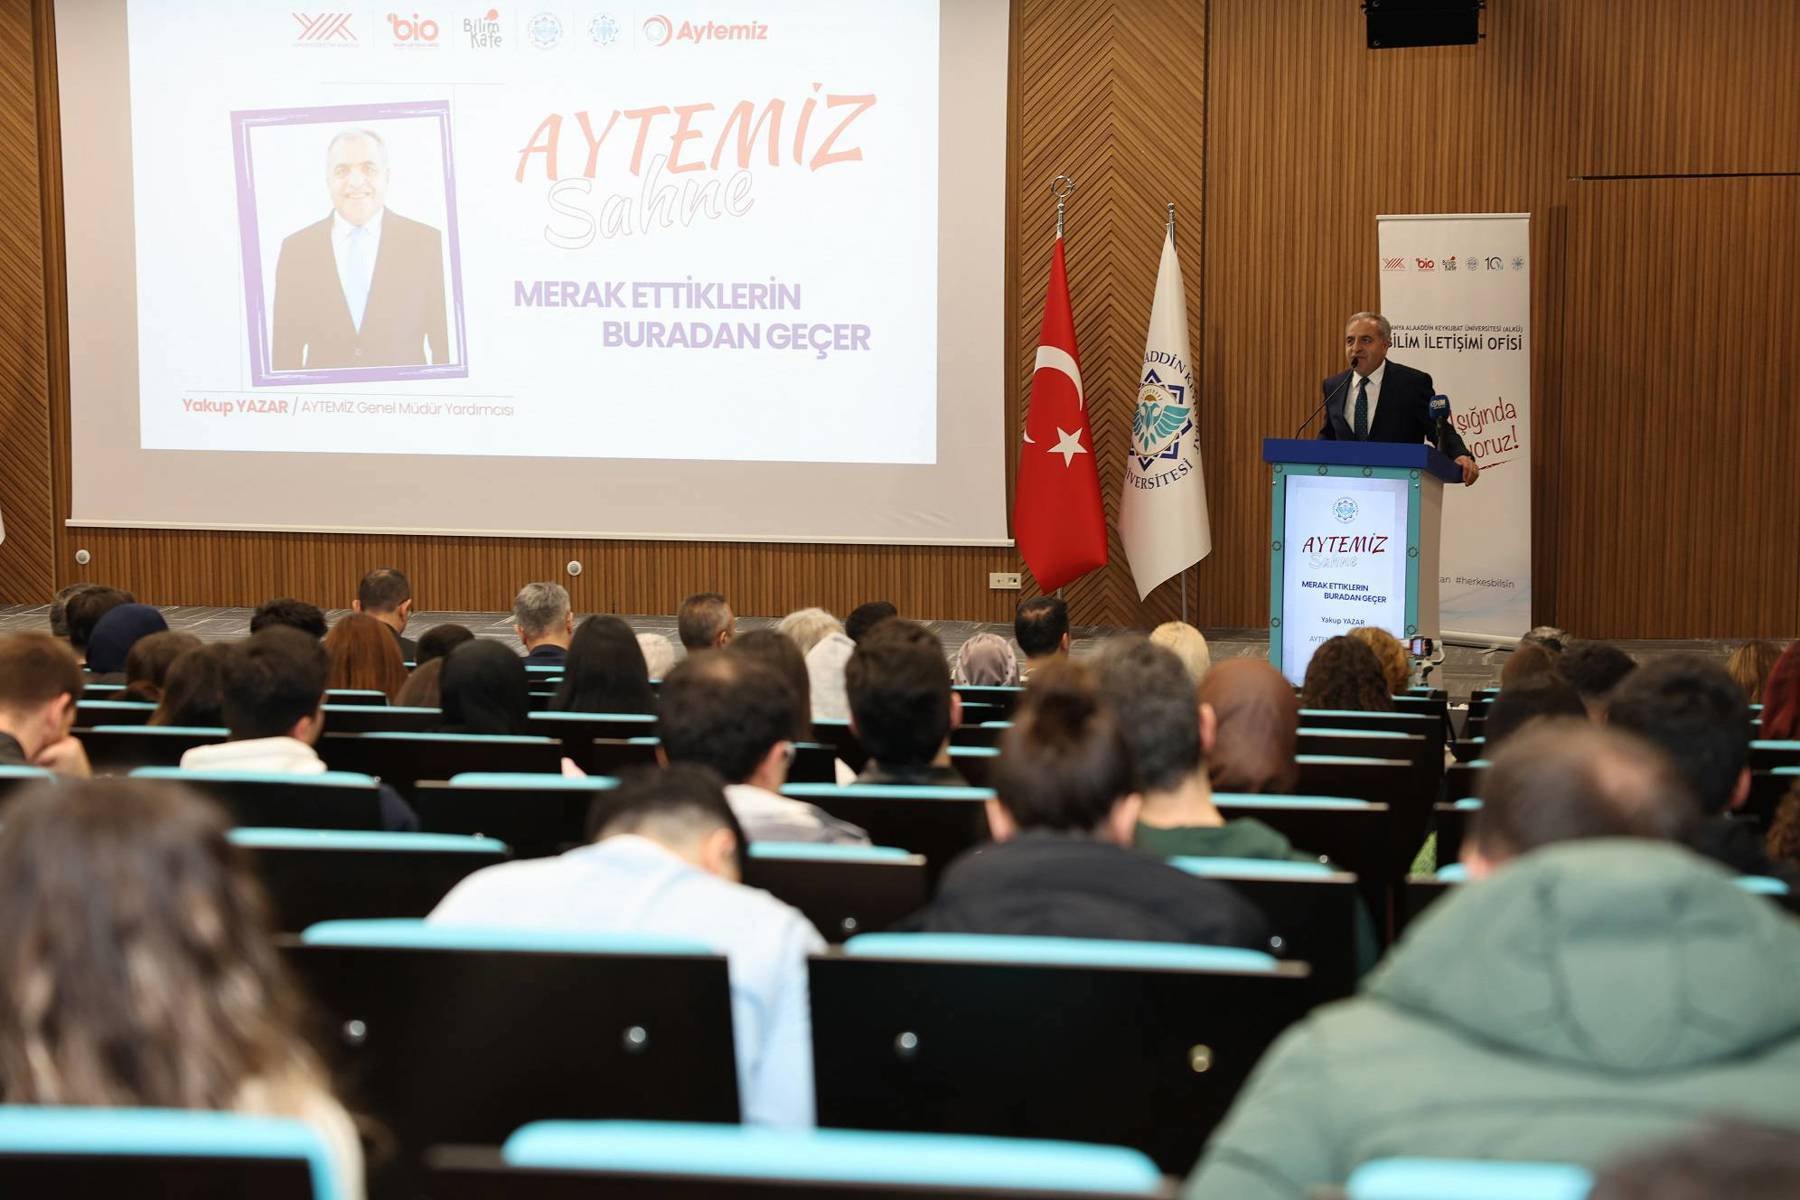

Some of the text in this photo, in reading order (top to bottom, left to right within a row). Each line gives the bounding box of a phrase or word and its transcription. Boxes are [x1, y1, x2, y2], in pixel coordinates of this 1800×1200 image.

[391, 14, 439, 42] bio
[463, 17, 500, 35] Bilim
[676, 21, 768, 44] Aytemiz
[471, 32, 503, 49] Kafe
[514, 82, 877, 183] AYTEMİZ
[544, 153, 755, 249] Sahne
[514, 275, 801, 310] MERAK ETTİKLERİN
[602, 321, 871, 360] BURADAN GEÇER
[1390, 333, 1523, 352] İLİM İLETİŞİMİ OFİSİ
[182, 398, 233, 416] Yakup
[236, 399, 288, 414] YAZAR
[301, 399, 354, 413] AYTEMİZ
[356, 401, 395, 414] Genel
[399, 401, 442, 415] Müdür
[1469, 425, 1519, 458] oruz!
[1302, 533, 1388, 554] AYTEMİZ
[1301, 580, 1328, 589] MERAK
[1324, 592, 1387, 604] BURADAN GEÇER
[1321, 616, 1366, 626] Yakup YAZAR
